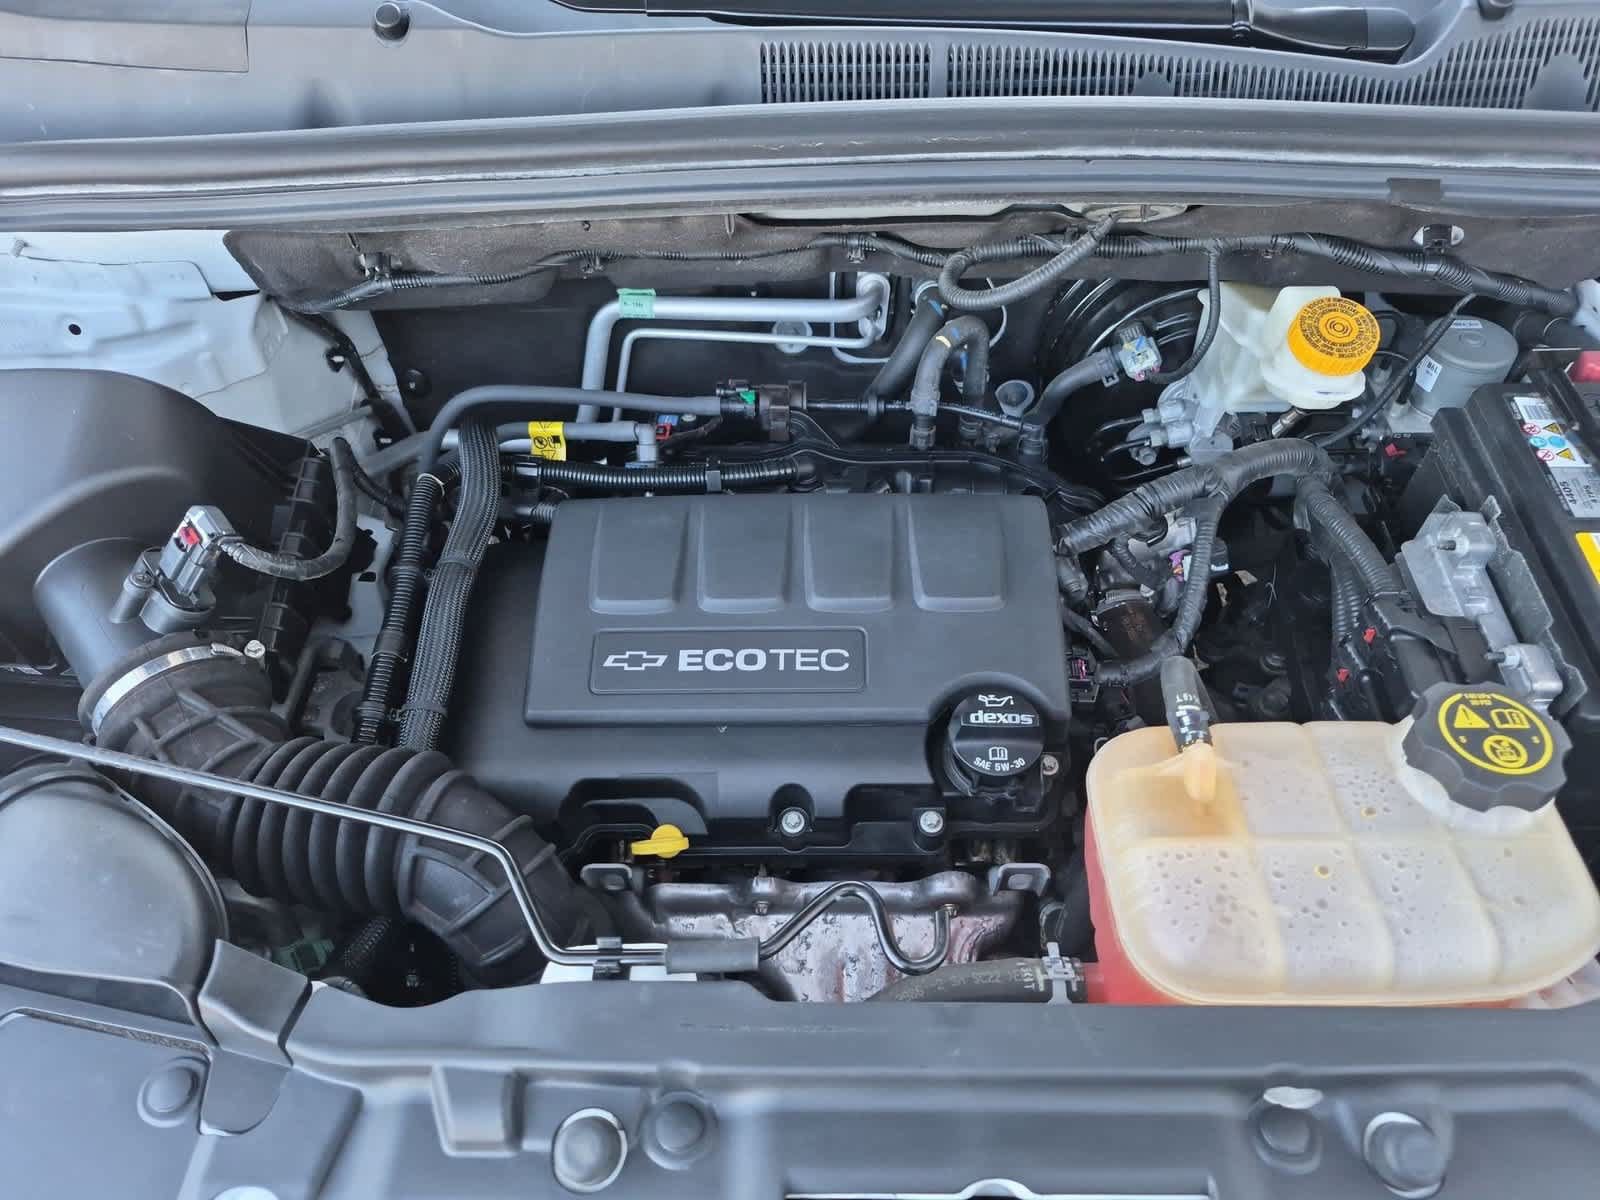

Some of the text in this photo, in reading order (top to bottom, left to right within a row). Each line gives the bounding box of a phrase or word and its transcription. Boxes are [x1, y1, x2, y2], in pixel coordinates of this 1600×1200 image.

[678, 648, 850, 672] ECOTEC
[970, 710, 1035, 725] dexos
[973, 757, 1026, 771] SAE 5W-30
